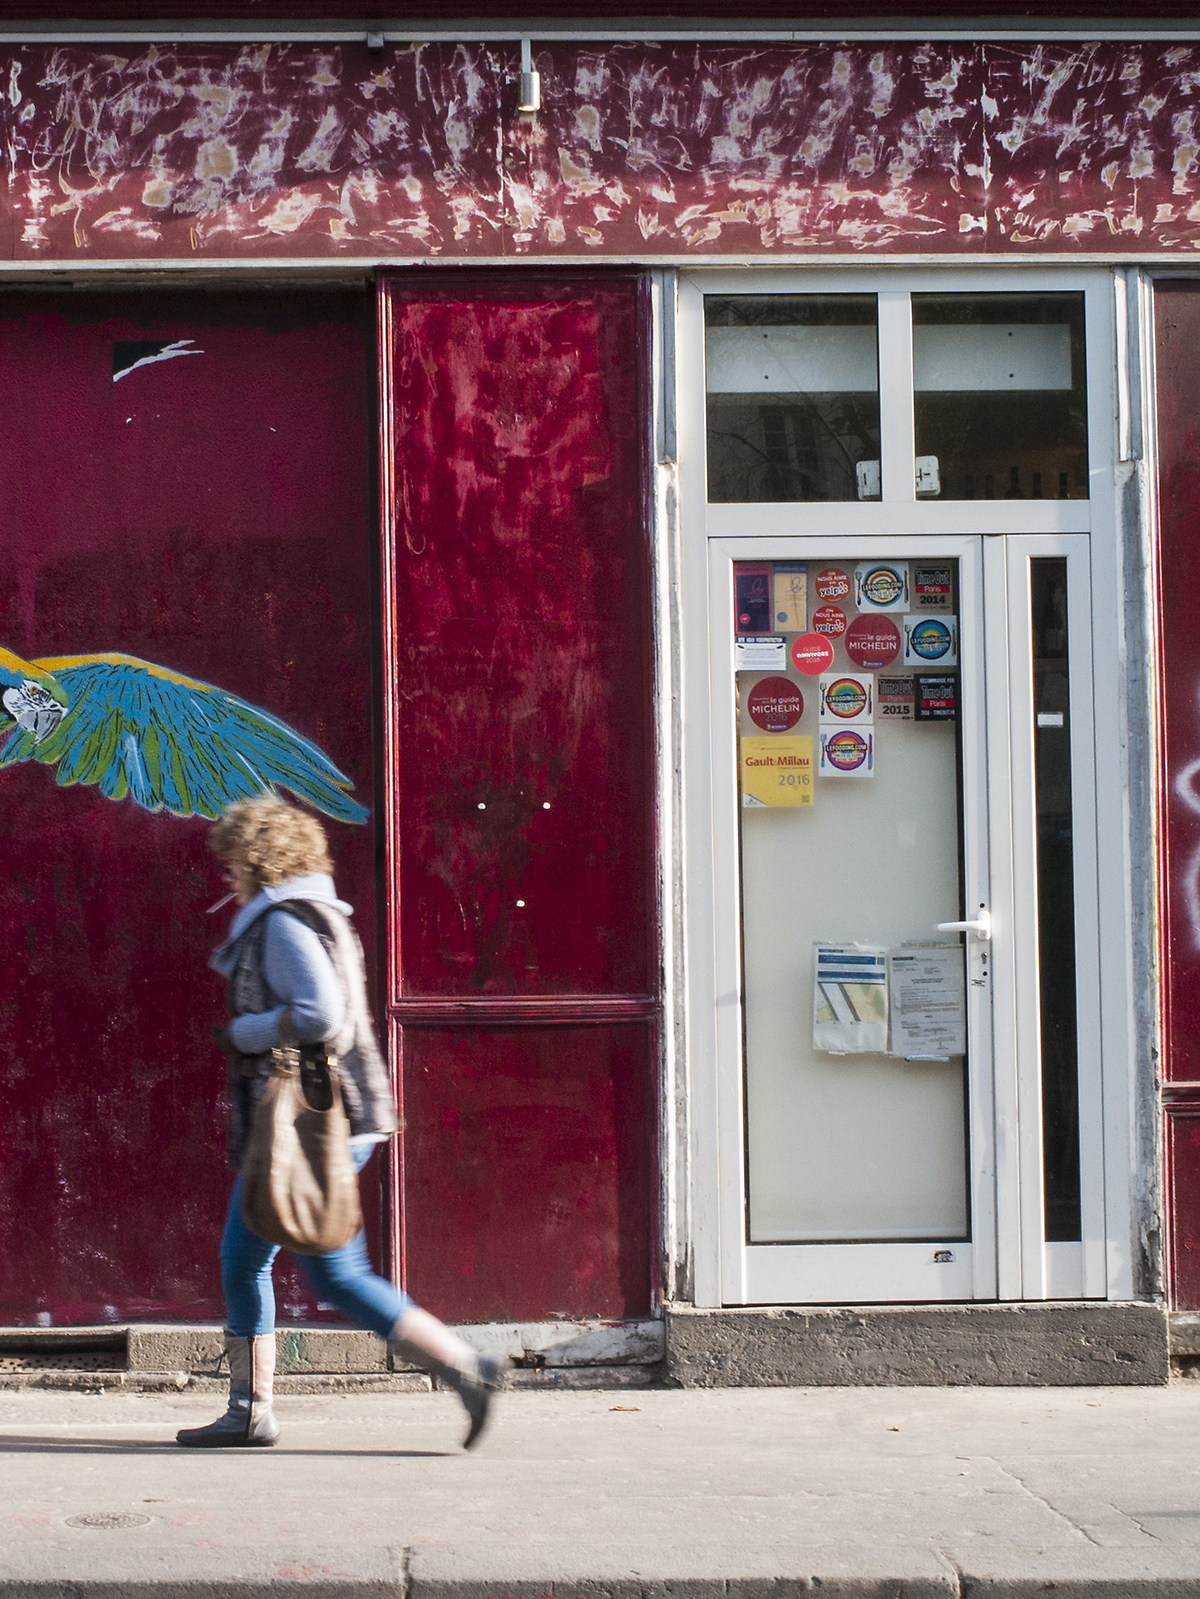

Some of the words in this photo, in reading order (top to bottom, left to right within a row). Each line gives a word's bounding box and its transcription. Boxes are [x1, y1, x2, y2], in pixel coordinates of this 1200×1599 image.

[920, 596, 946, 604] 2014
[849, 642, 897, 650] MICHELIN
[752, 704, 800, 714] MICHELIN
[882, 706, 910, 715] 2015
[765, 713, 787, 721] 2016
[778, 774, 810, 786] 2016
